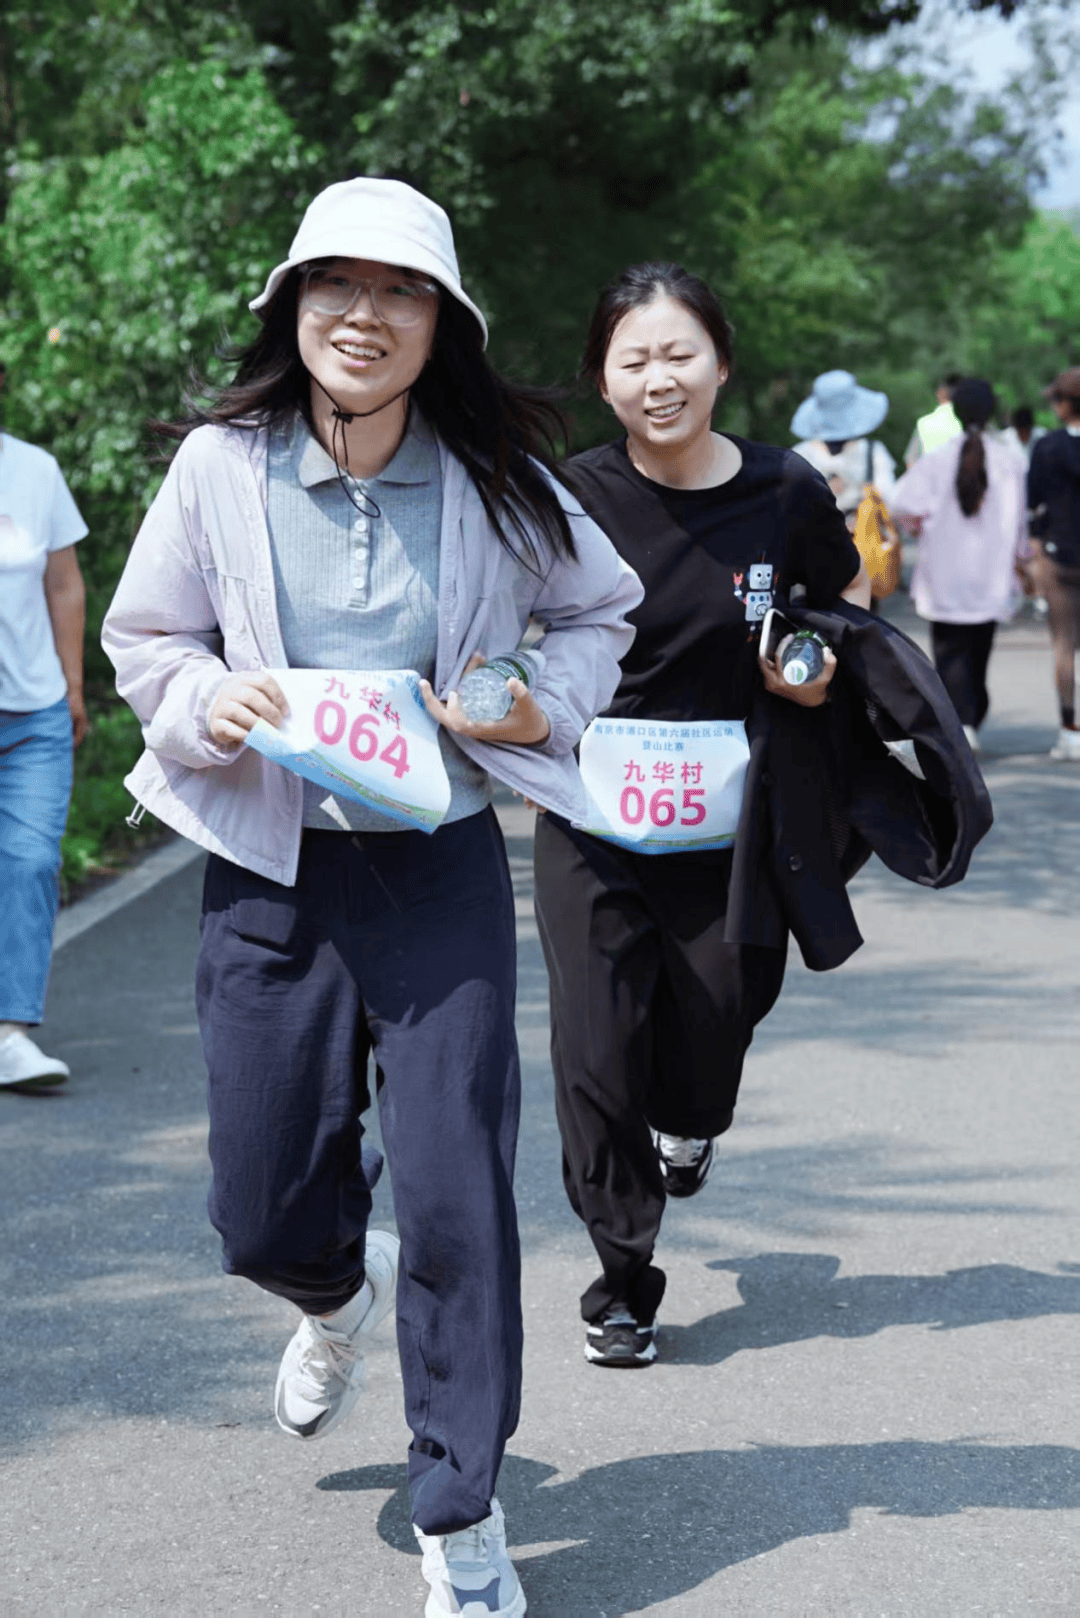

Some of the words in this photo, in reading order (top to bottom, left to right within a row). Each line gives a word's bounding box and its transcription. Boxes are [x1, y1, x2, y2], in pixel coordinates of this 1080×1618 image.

[314, 700, 410, 779] 064
[623, 759, 704, 784] 九华村
[620, 786, 706, 827] 065
